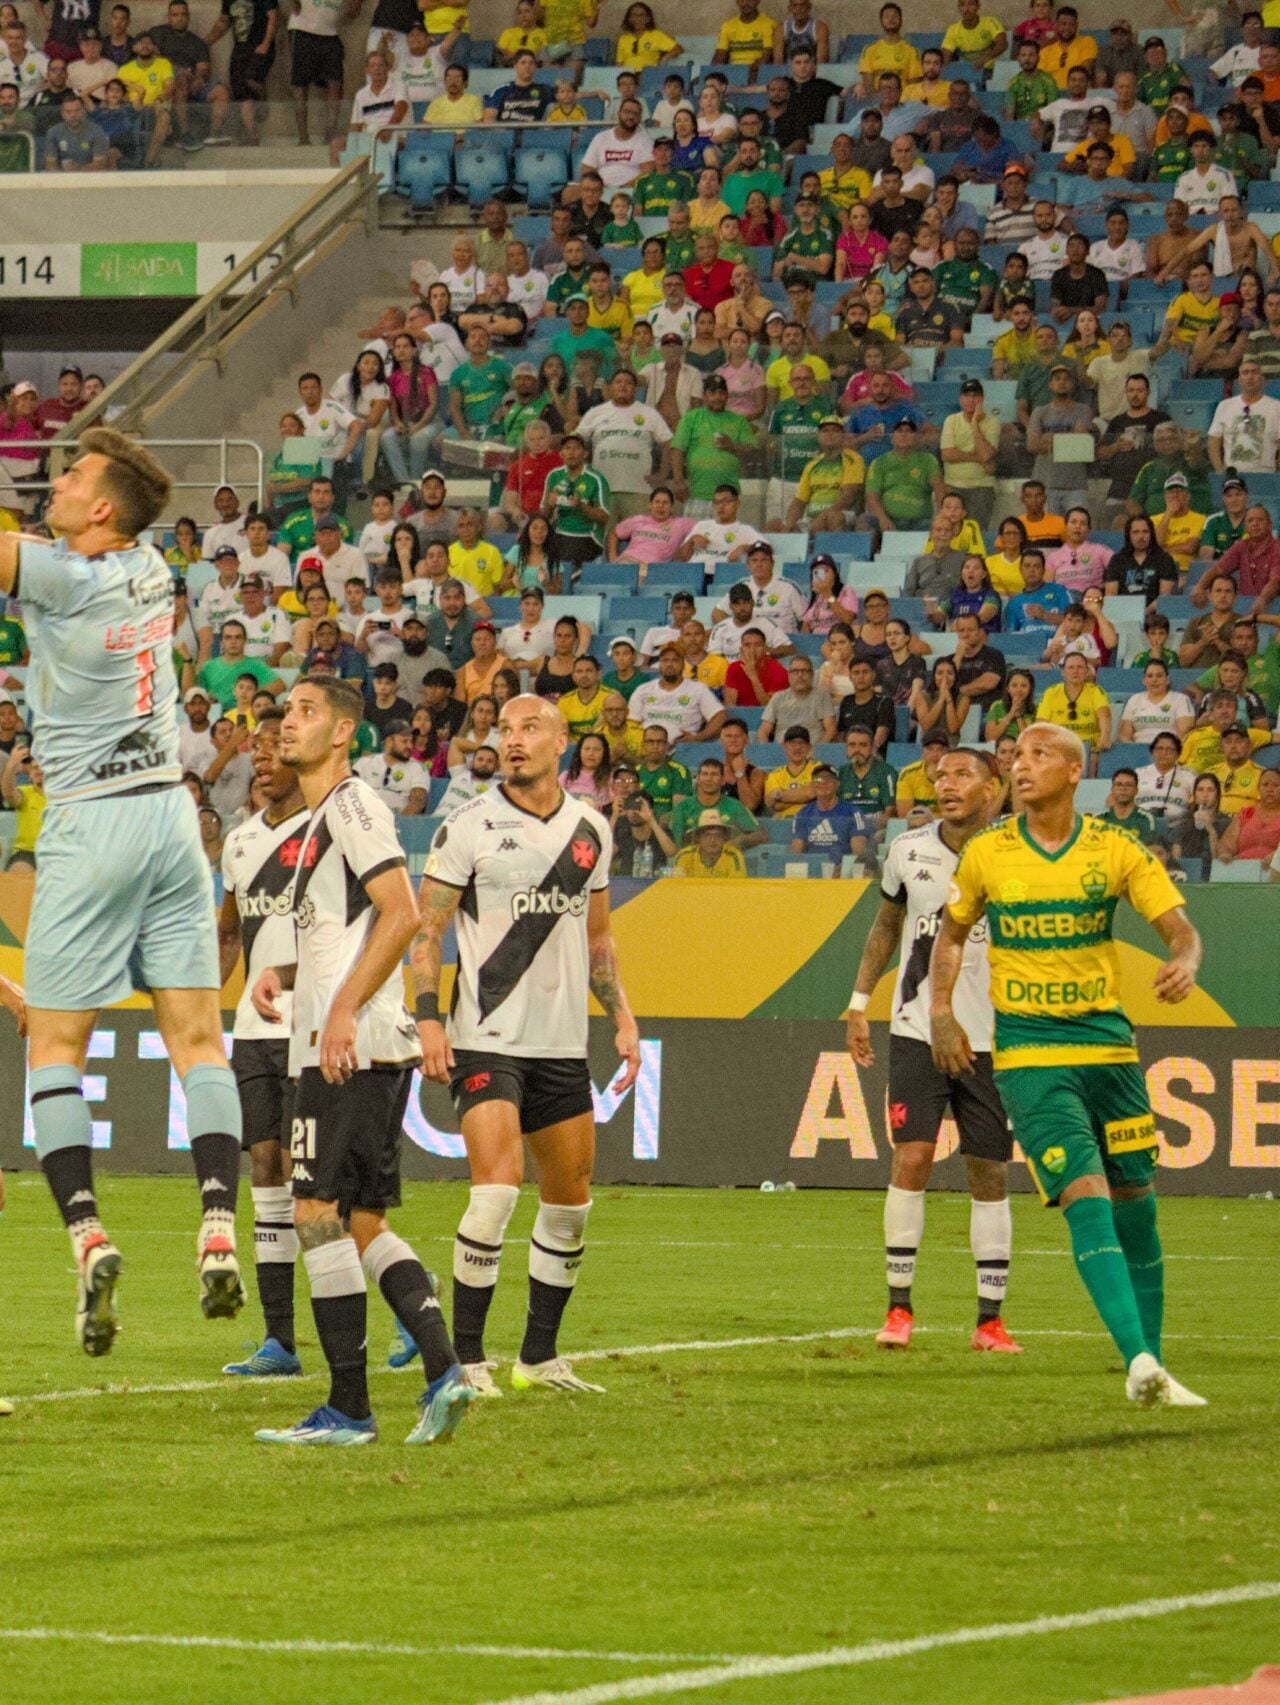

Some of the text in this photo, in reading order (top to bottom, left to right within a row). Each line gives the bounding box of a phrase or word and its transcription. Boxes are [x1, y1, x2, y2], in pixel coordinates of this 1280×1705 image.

[134, 650, 157, 718] 1
[808, 832, 839, 843] adidas
[999, 910, 1107, 940] DREBOR
[1006, 977, 1107, 1006] DREBOR
[290, 1118, 317, 1159] 21
